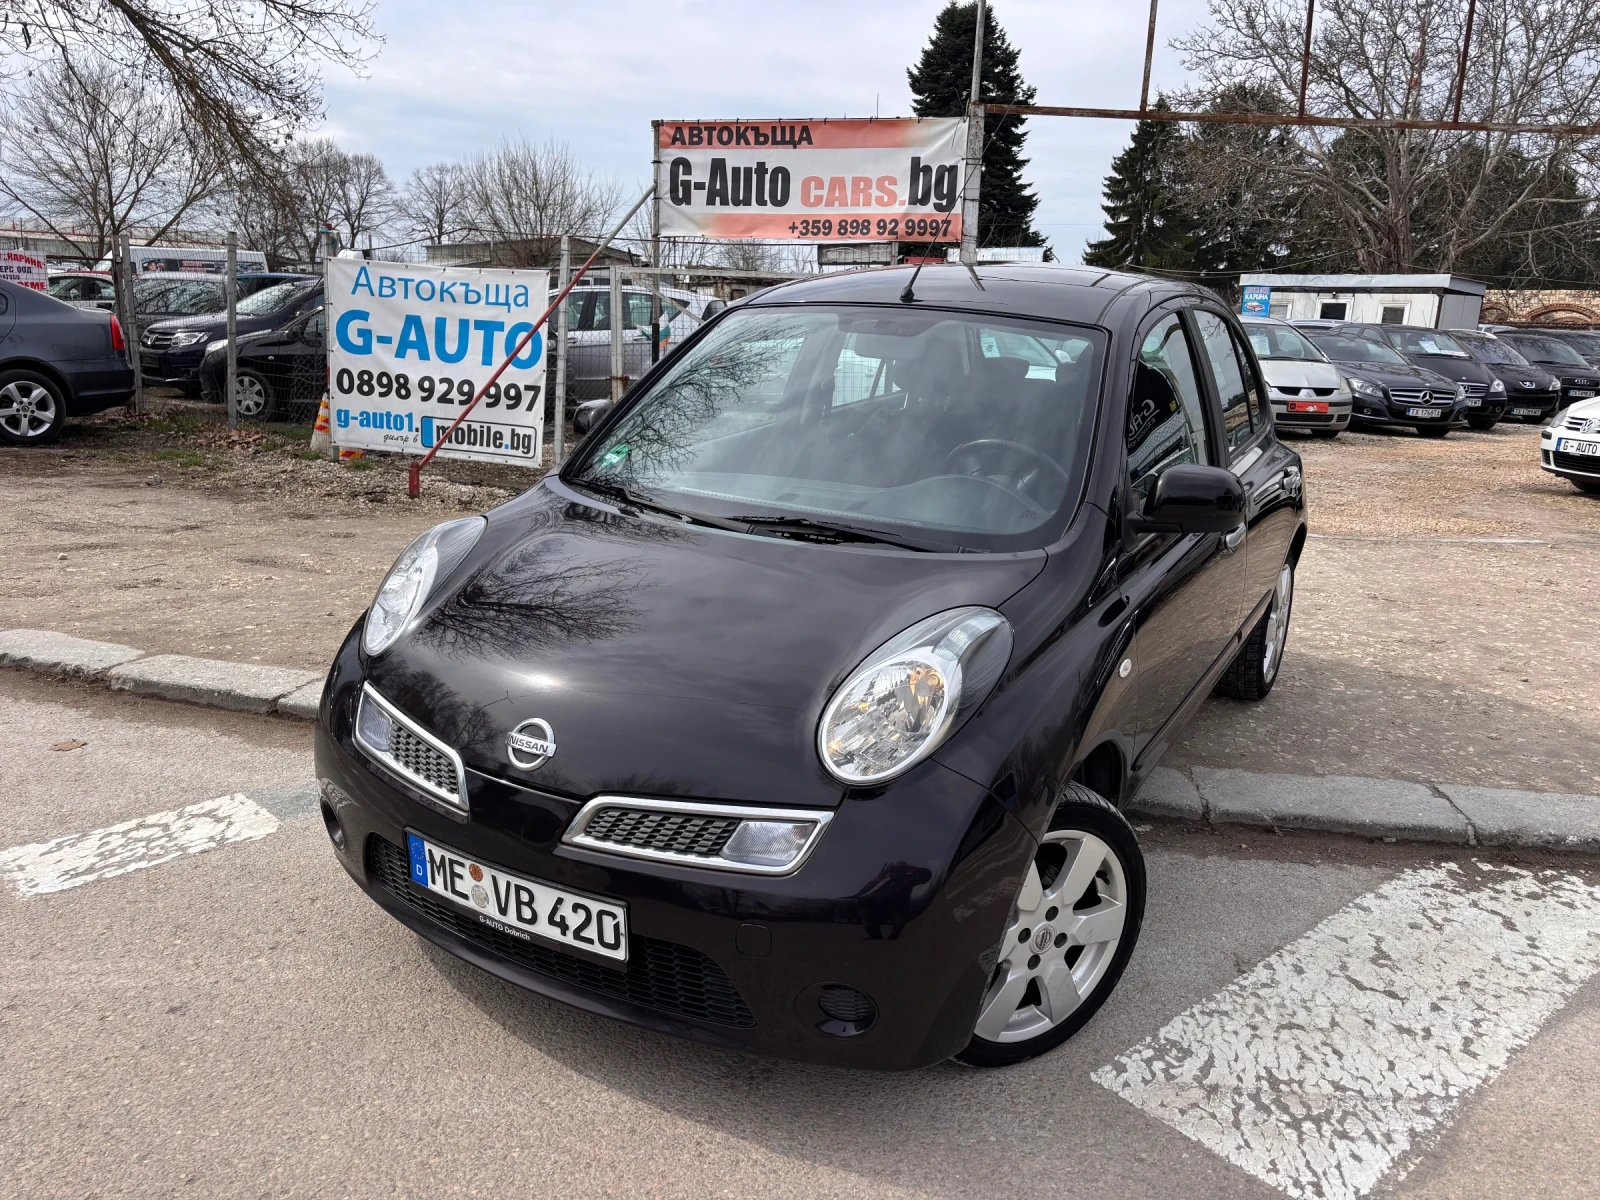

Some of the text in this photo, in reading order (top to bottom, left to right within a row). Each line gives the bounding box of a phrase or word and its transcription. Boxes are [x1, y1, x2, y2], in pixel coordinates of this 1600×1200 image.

[670, 124, 814, 149] АВТОКЪЩА
[669, 156, 791, 208] G-Auto
[788, 219, 952, 238] +359 898 92 9997
[350, 265, 529, 313] Автокъща
[335, 309, 543, 370] G-AUTO
[336, 367, 541, 412] 0898 929 997
[436, 423, 532, 455] mobile.bg
[510, 735, 549, 753] NISSAN
[416, 848, 621, 951] D ME VB 420
[479, 915, 531, 941] G-AUTO Dobrich
